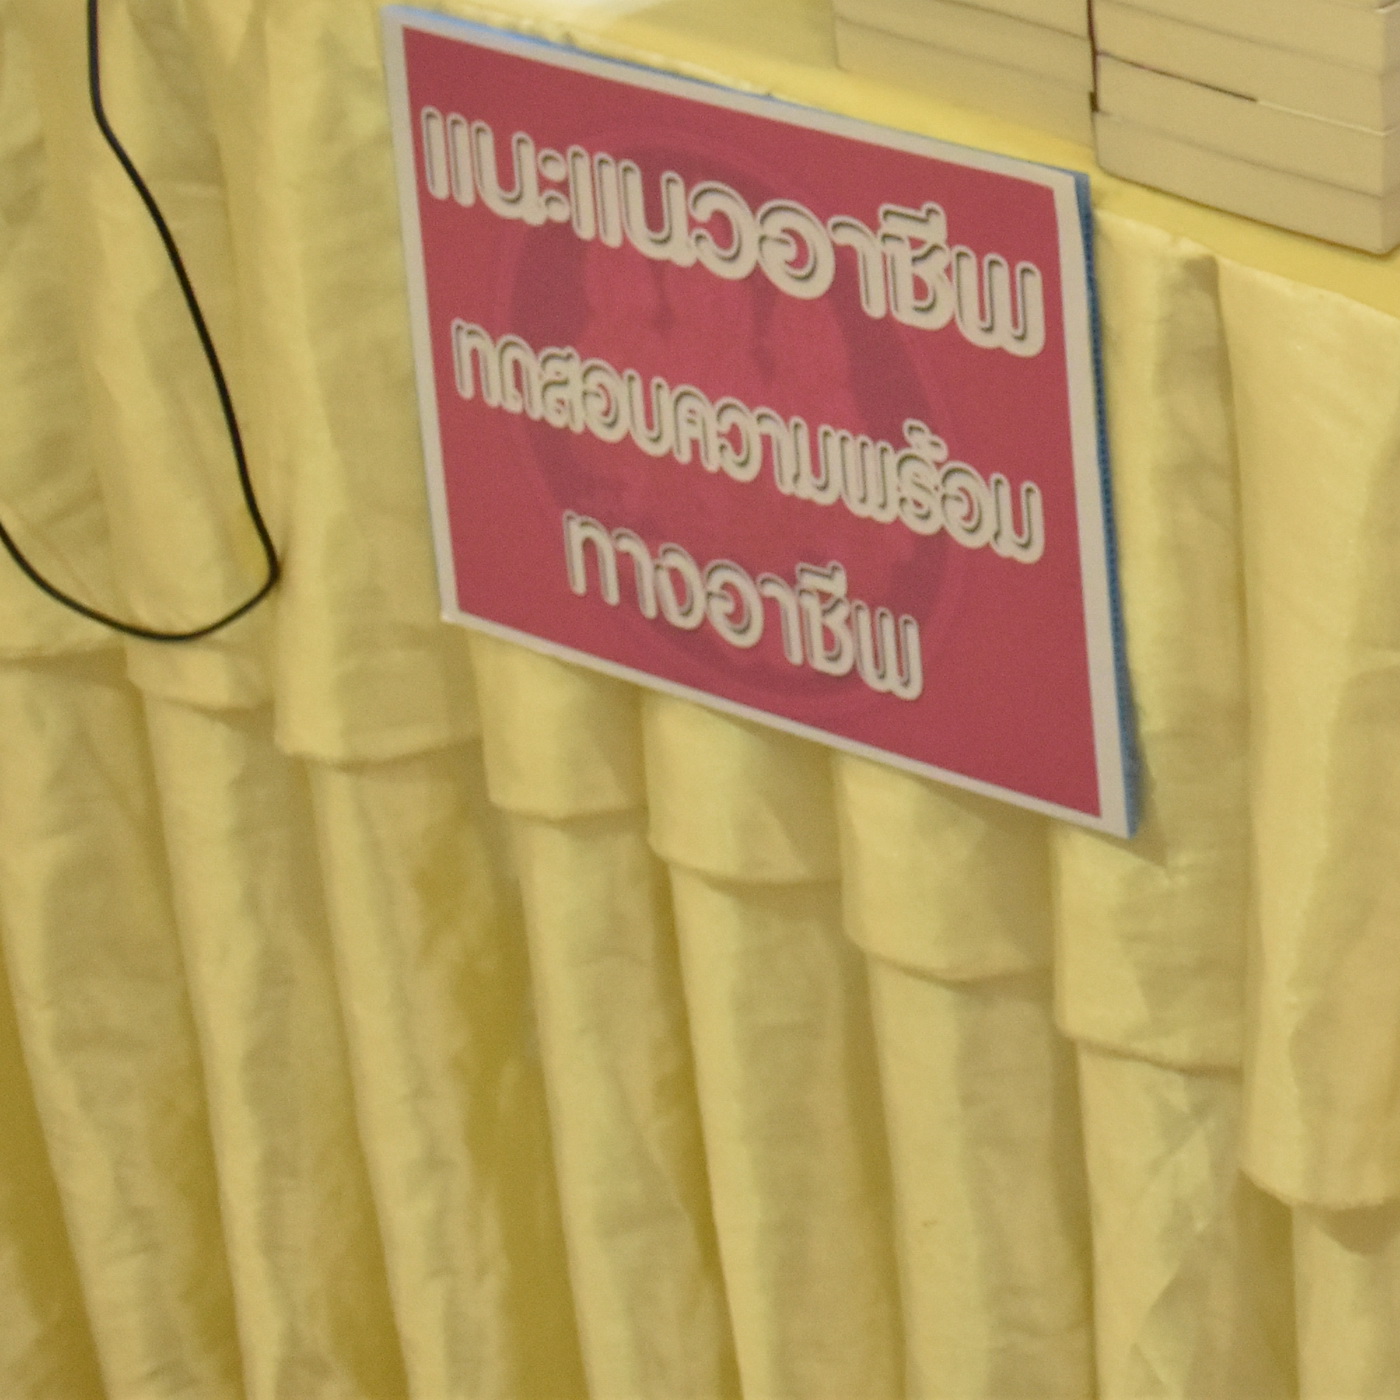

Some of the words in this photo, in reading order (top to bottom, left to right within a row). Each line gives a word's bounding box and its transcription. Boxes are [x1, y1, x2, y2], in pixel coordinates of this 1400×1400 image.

[420, 106, 1048, 360] แนะแนวอาชีพ
[452, 318, 1048, 566] ทดสอบความพร้อม
[562, 508, 926, 702] ทางอาชีพ
